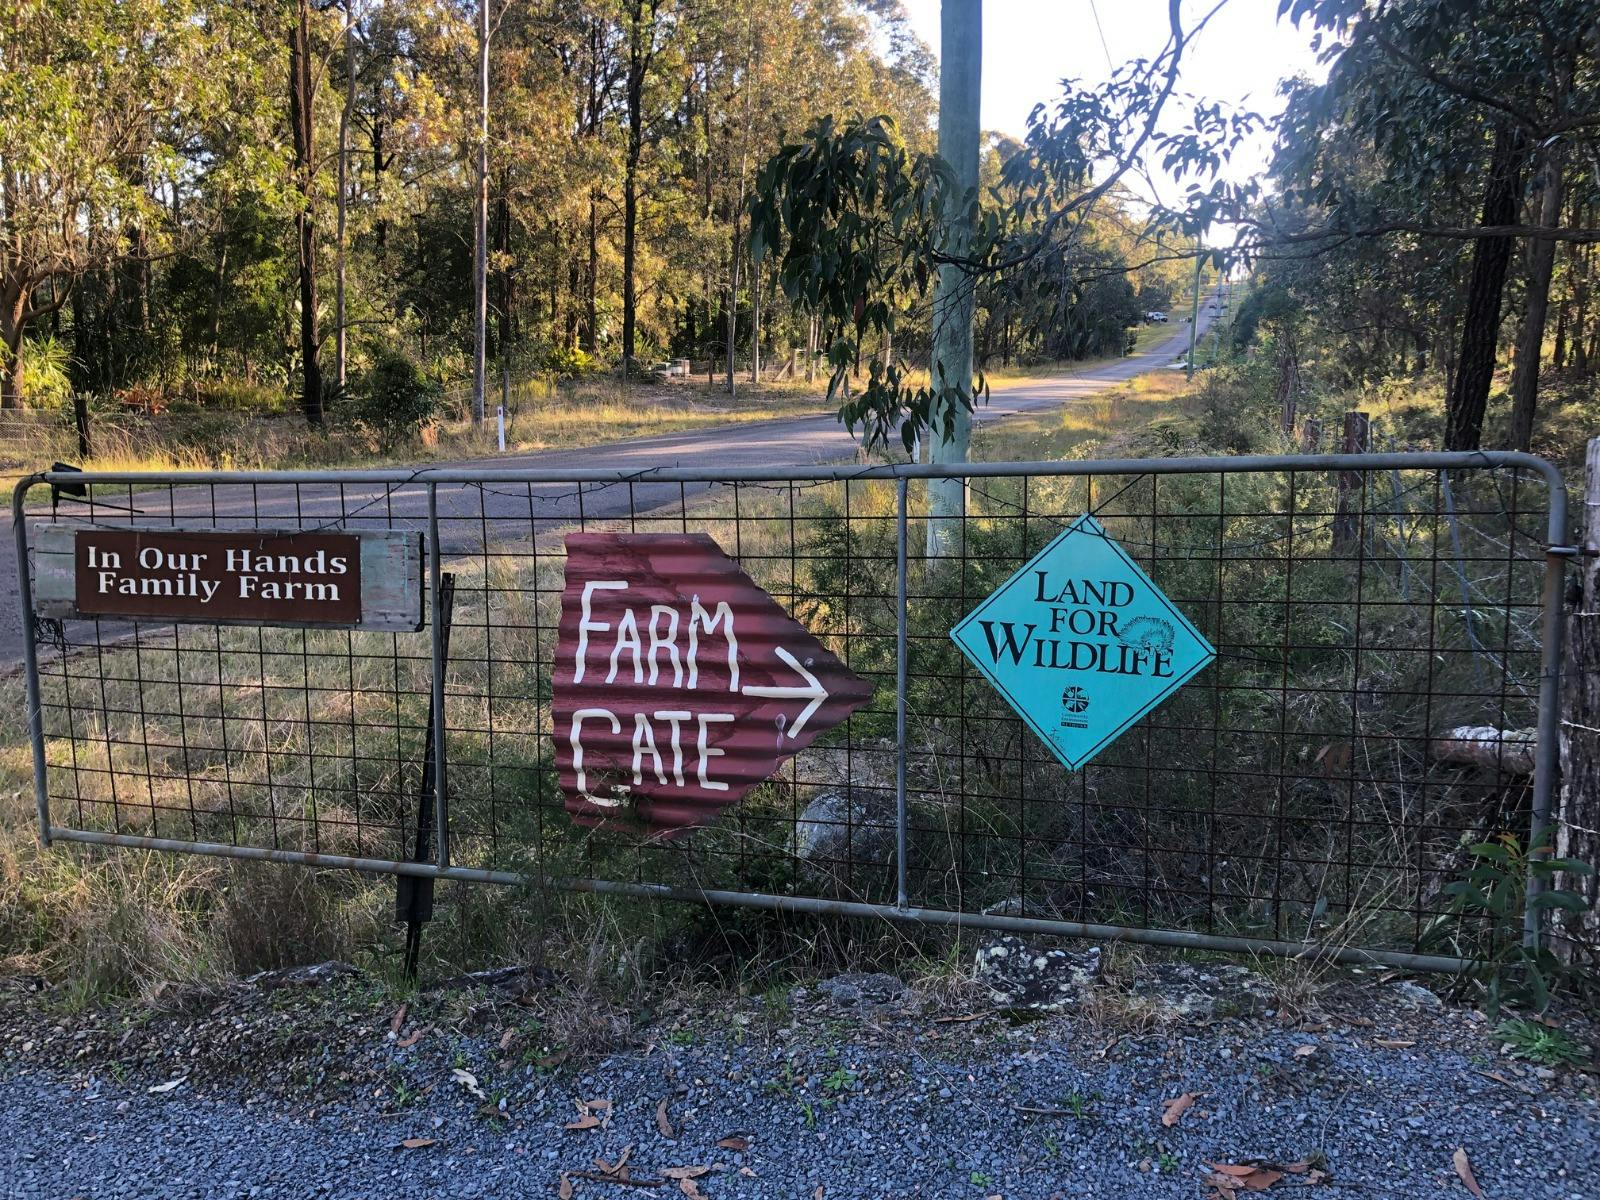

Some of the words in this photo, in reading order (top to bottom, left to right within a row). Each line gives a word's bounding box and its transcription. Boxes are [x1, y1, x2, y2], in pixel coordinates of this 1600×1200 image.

[87, 545, 122, 569] In
[139, 547, 207, 571] Our
[225, 549, 348, 574] Hands
[98, 571, 221, 602] Family
[239, 576, 340, 600] Farm
[1034, 571, 1134, 607] LAND
[574, 580, 739, 692] FARM
[1049, 607, 1120, 637] FOR
[978, 620, 1174, 678] WILDLIFE
[570, 708, 735, 807] GATE
